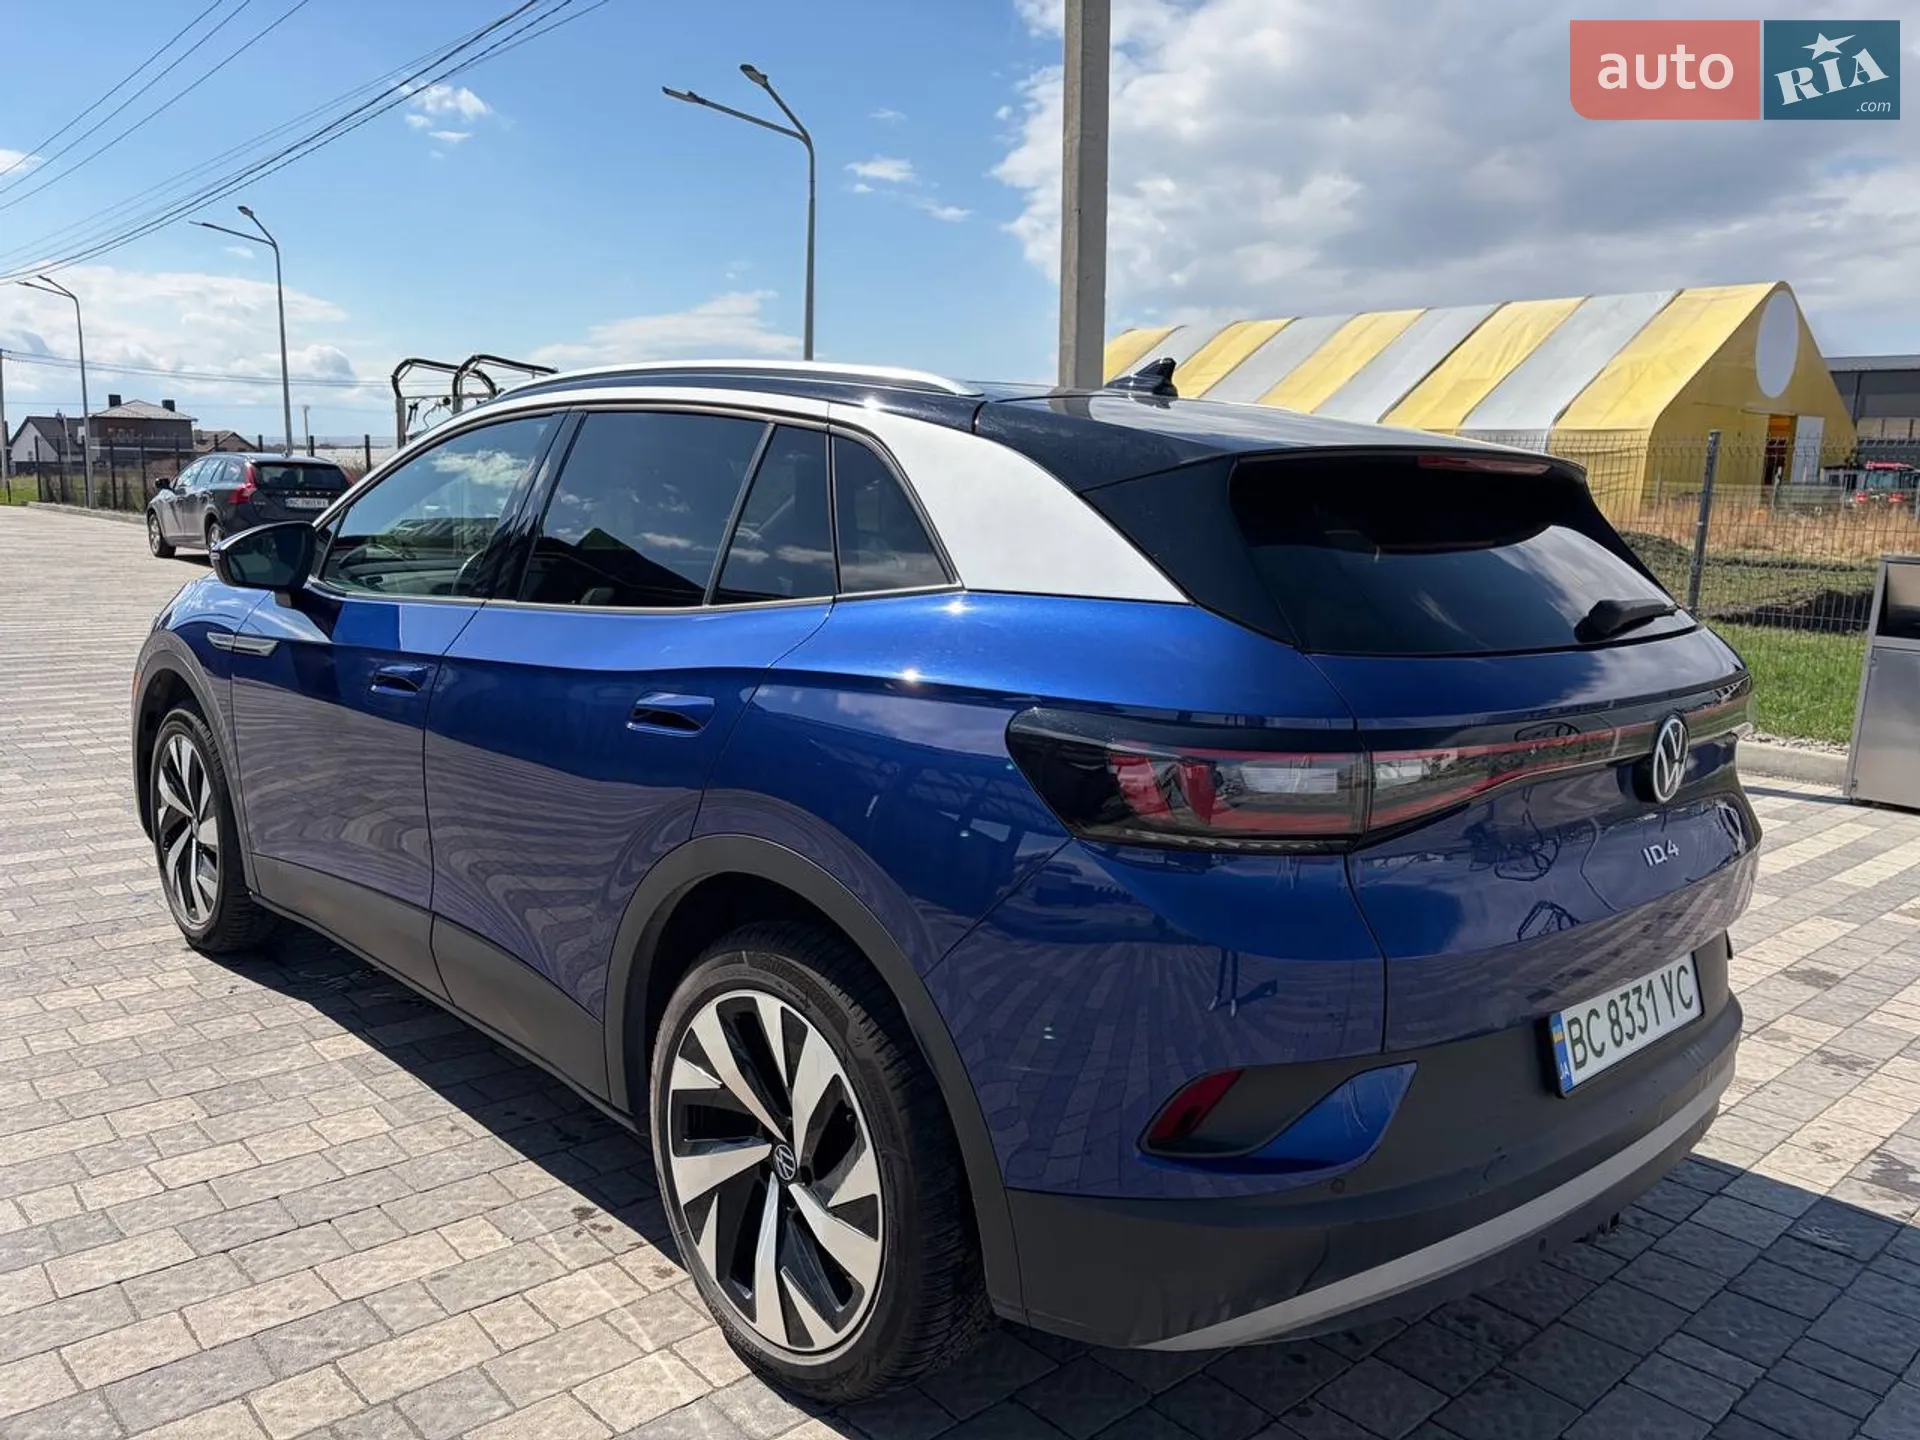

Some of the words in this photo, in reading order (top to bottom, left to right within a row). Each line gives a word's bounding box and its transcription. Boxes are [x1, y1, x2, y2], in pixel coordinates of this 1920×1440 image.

[1567, 1008, 1605, 1071] BC
[1607, 979, 1660, 1048] 8331
[1661, 965, 1693, 1018] YC
